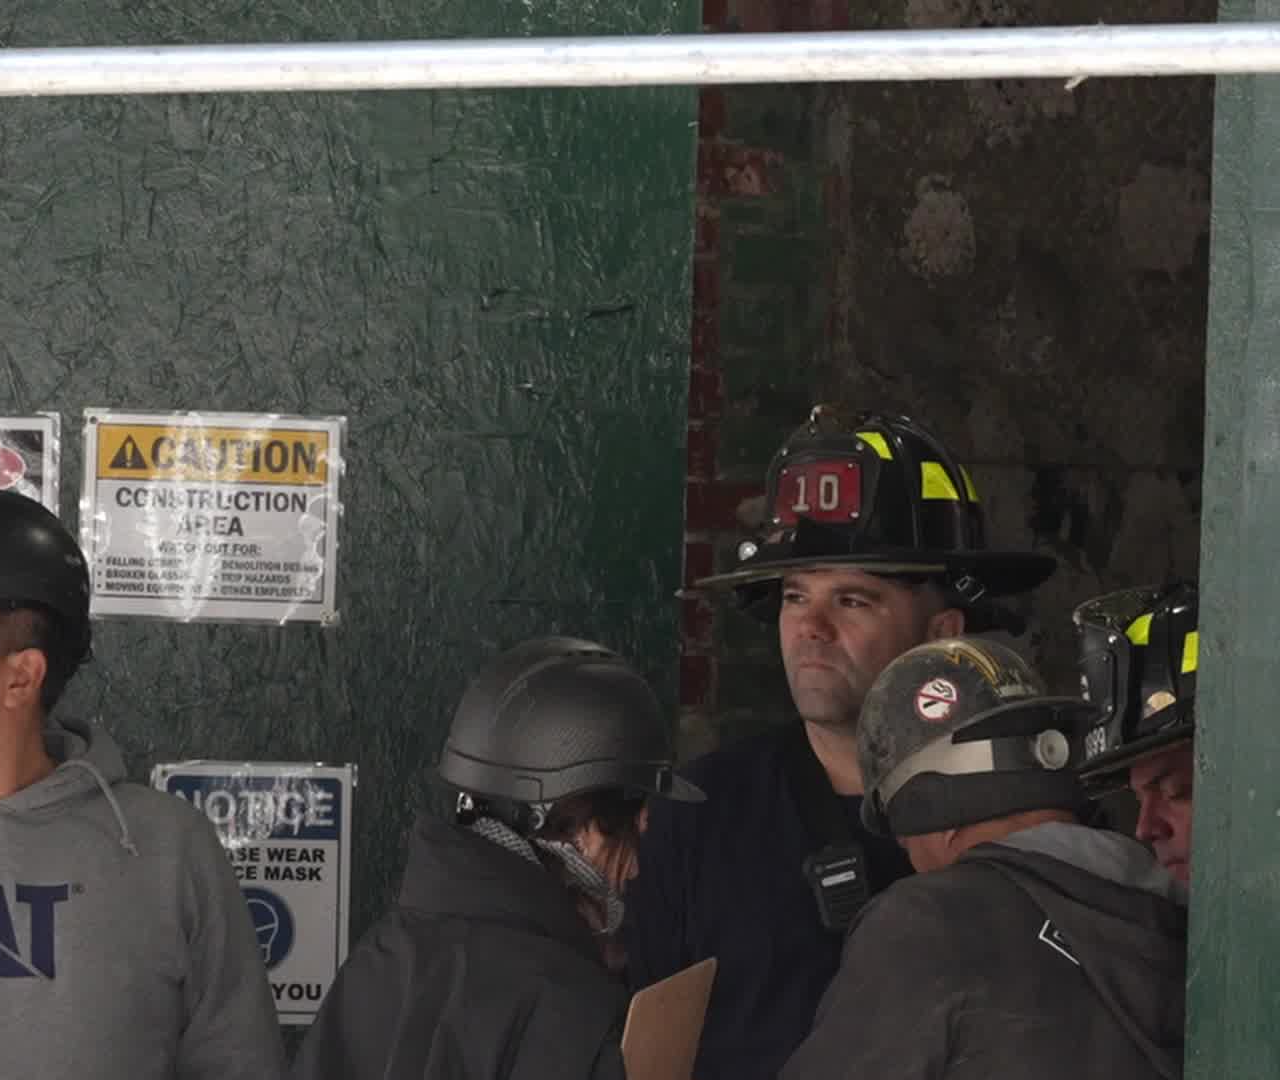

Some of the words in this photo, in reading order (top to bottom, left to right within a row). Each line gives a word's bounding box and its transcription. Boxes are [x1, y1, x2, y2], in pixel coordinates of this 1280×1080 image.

[151, 436, 319, 474] CAUTION
[792, 474, 839, 512] 10
[267, 847, 326, 863] WEAR
[232, 866, 257, 880] CE
[264, 866, 322, 881] MASK
[272, 983, 322, 1001] YOU
